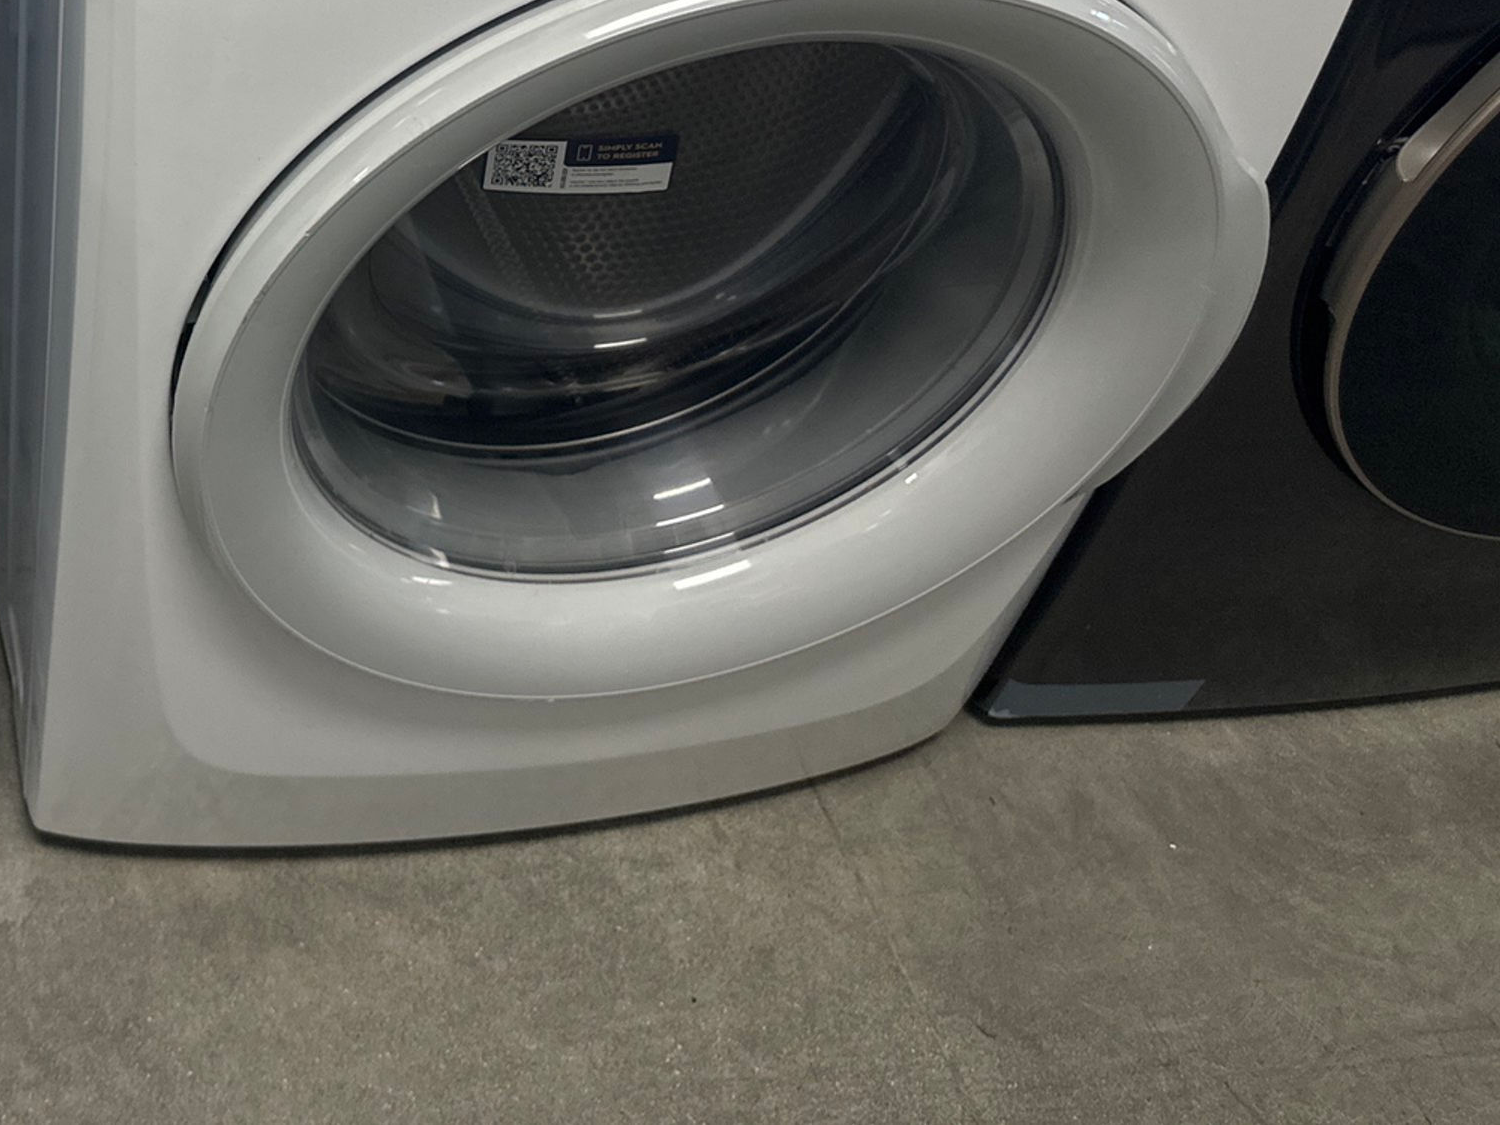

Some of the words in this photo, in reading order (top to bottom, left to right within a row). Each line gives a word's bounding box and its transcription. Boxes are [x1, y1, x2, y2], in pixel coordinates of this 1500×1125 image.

[598, 143, 633, 152] SIMPLY
[634, 142, 663, 151] SCAN
[597, 152, 611, 160] TO
[613, 150, 659, 159] REGISTER
